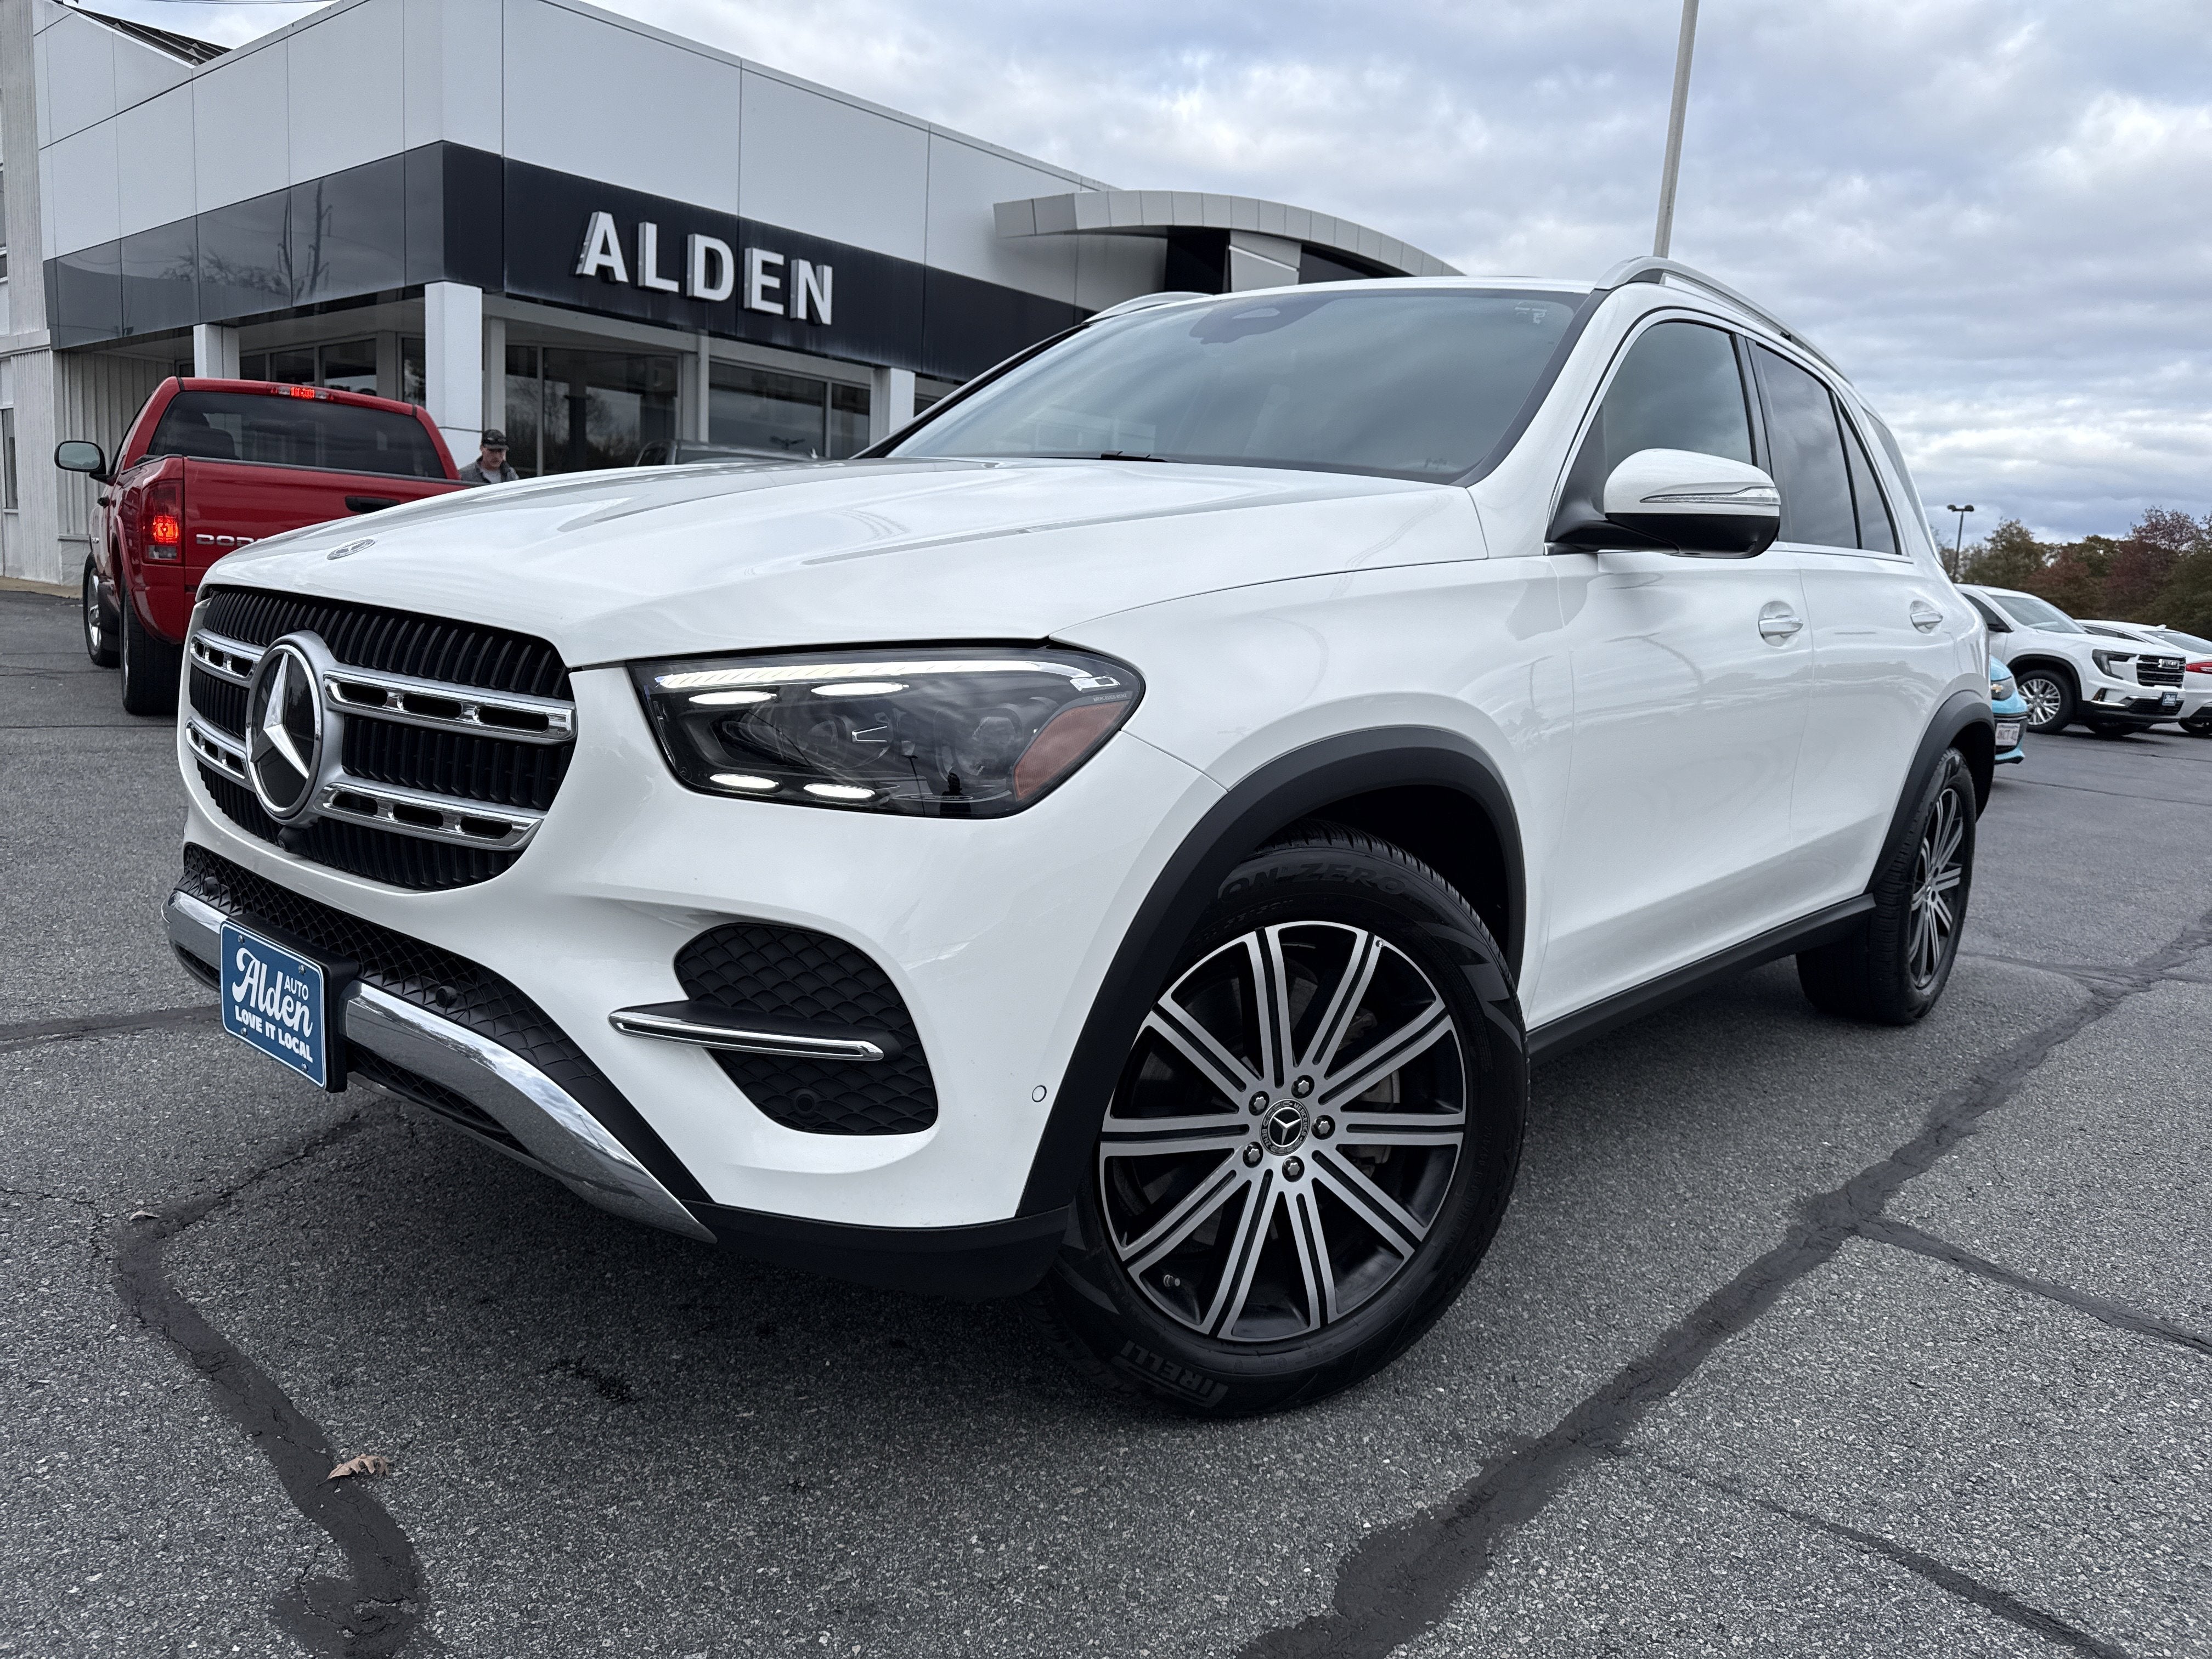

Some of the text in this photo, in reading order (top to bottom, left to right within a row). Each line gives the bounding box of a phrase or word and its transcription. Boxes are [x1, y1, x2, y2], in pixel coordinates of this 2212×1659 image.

[575, 211, 833, 325] ALDEN
[196, 534, 263, 546] DOD
[1294, 863, 1407, 895] ZERO
[232, 947, 313, 1037] Alden
[284, 975, 309, 1001] AUTO
[234, 1005, 313, 1063] LOVE IT LOCAL
[1293, 1102, 1309, 1136] MERCEDES
[1261, 1128, 1272, 1148] BENZ
[1111, 1340, 1229, 1408] PIRELLI
